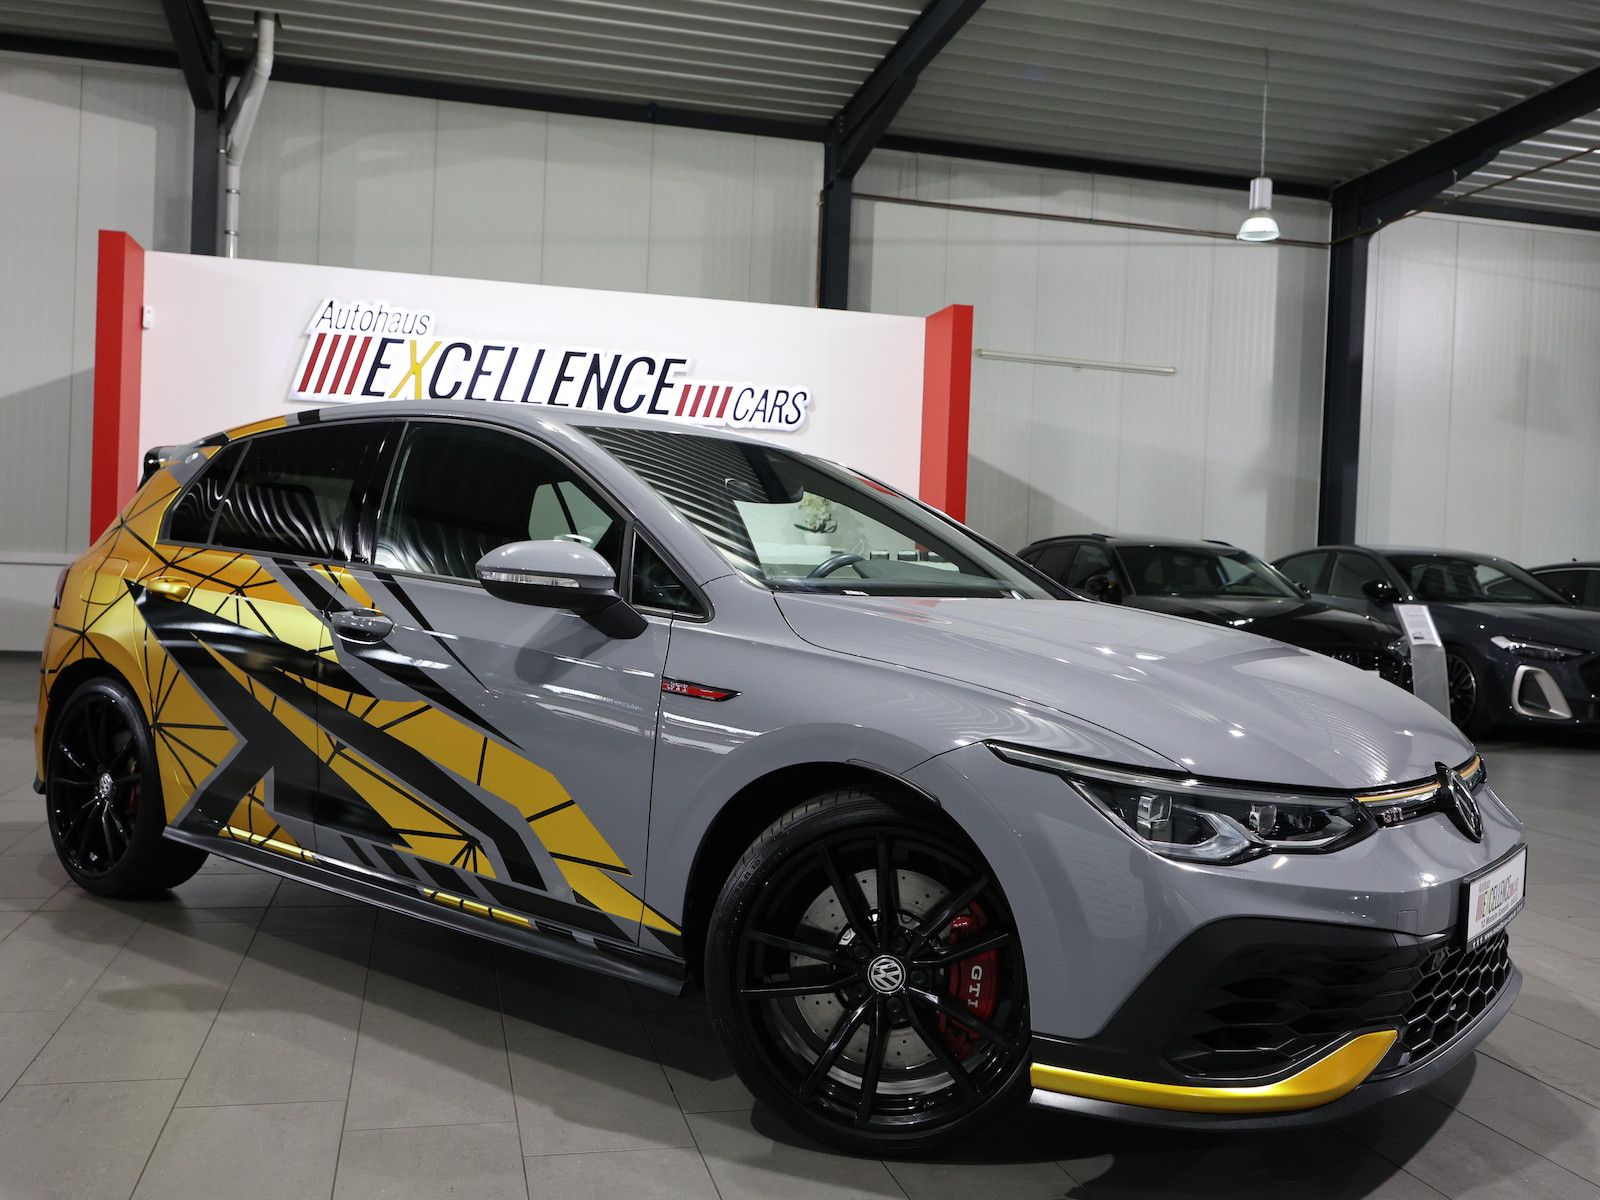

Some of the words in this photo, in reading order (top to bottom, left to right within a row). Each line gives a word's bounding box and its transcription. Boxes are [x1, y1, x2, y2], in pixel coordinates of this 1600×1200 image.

[315, 300, 431, 336] Autohaus
[361, 337, 688, 415] EXCELLENCE
[732, 387, 808, 425] CARS
[967, 965, 983, 1009] GTI
